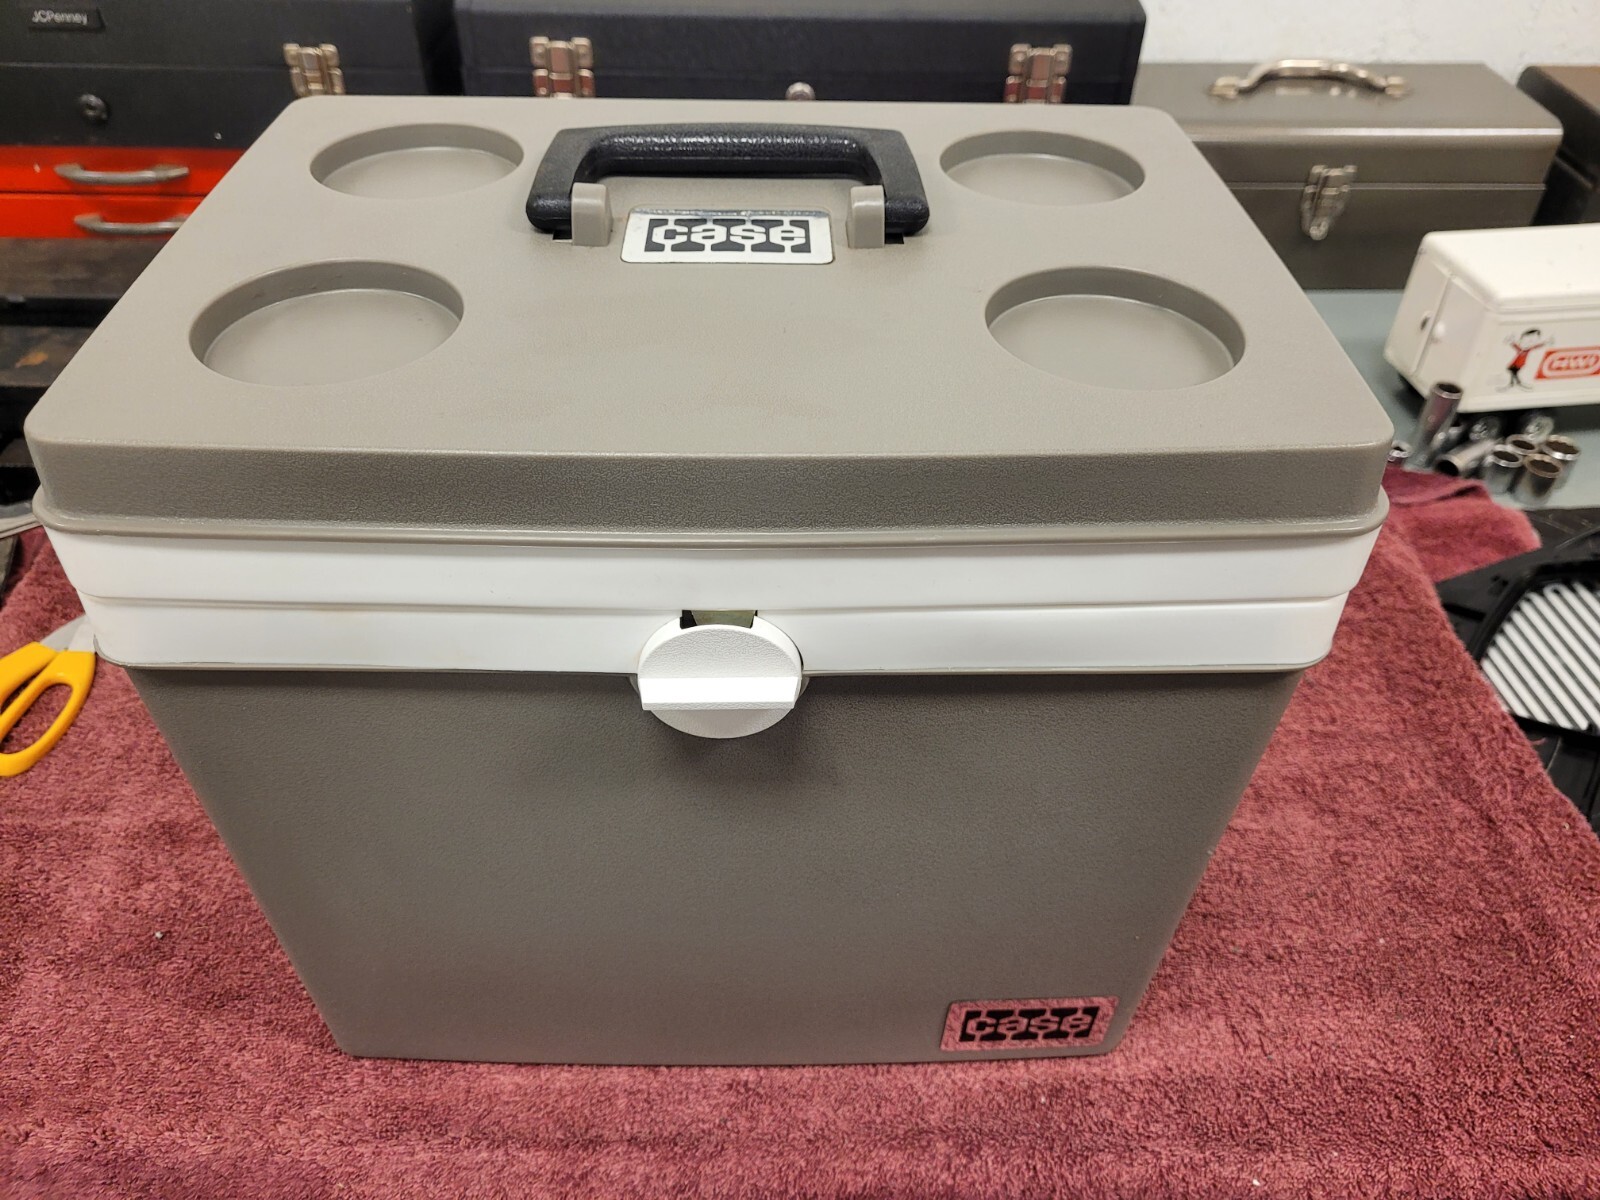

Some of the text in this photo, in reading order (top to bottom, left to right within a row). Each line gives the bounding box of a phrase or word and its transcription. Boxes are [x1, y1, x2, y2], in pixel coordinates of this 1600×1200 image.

[31, 9, 88, 25] JCPenney
[649, 222, 807, 251] case
[963, 1010, 1096, 1040] case
